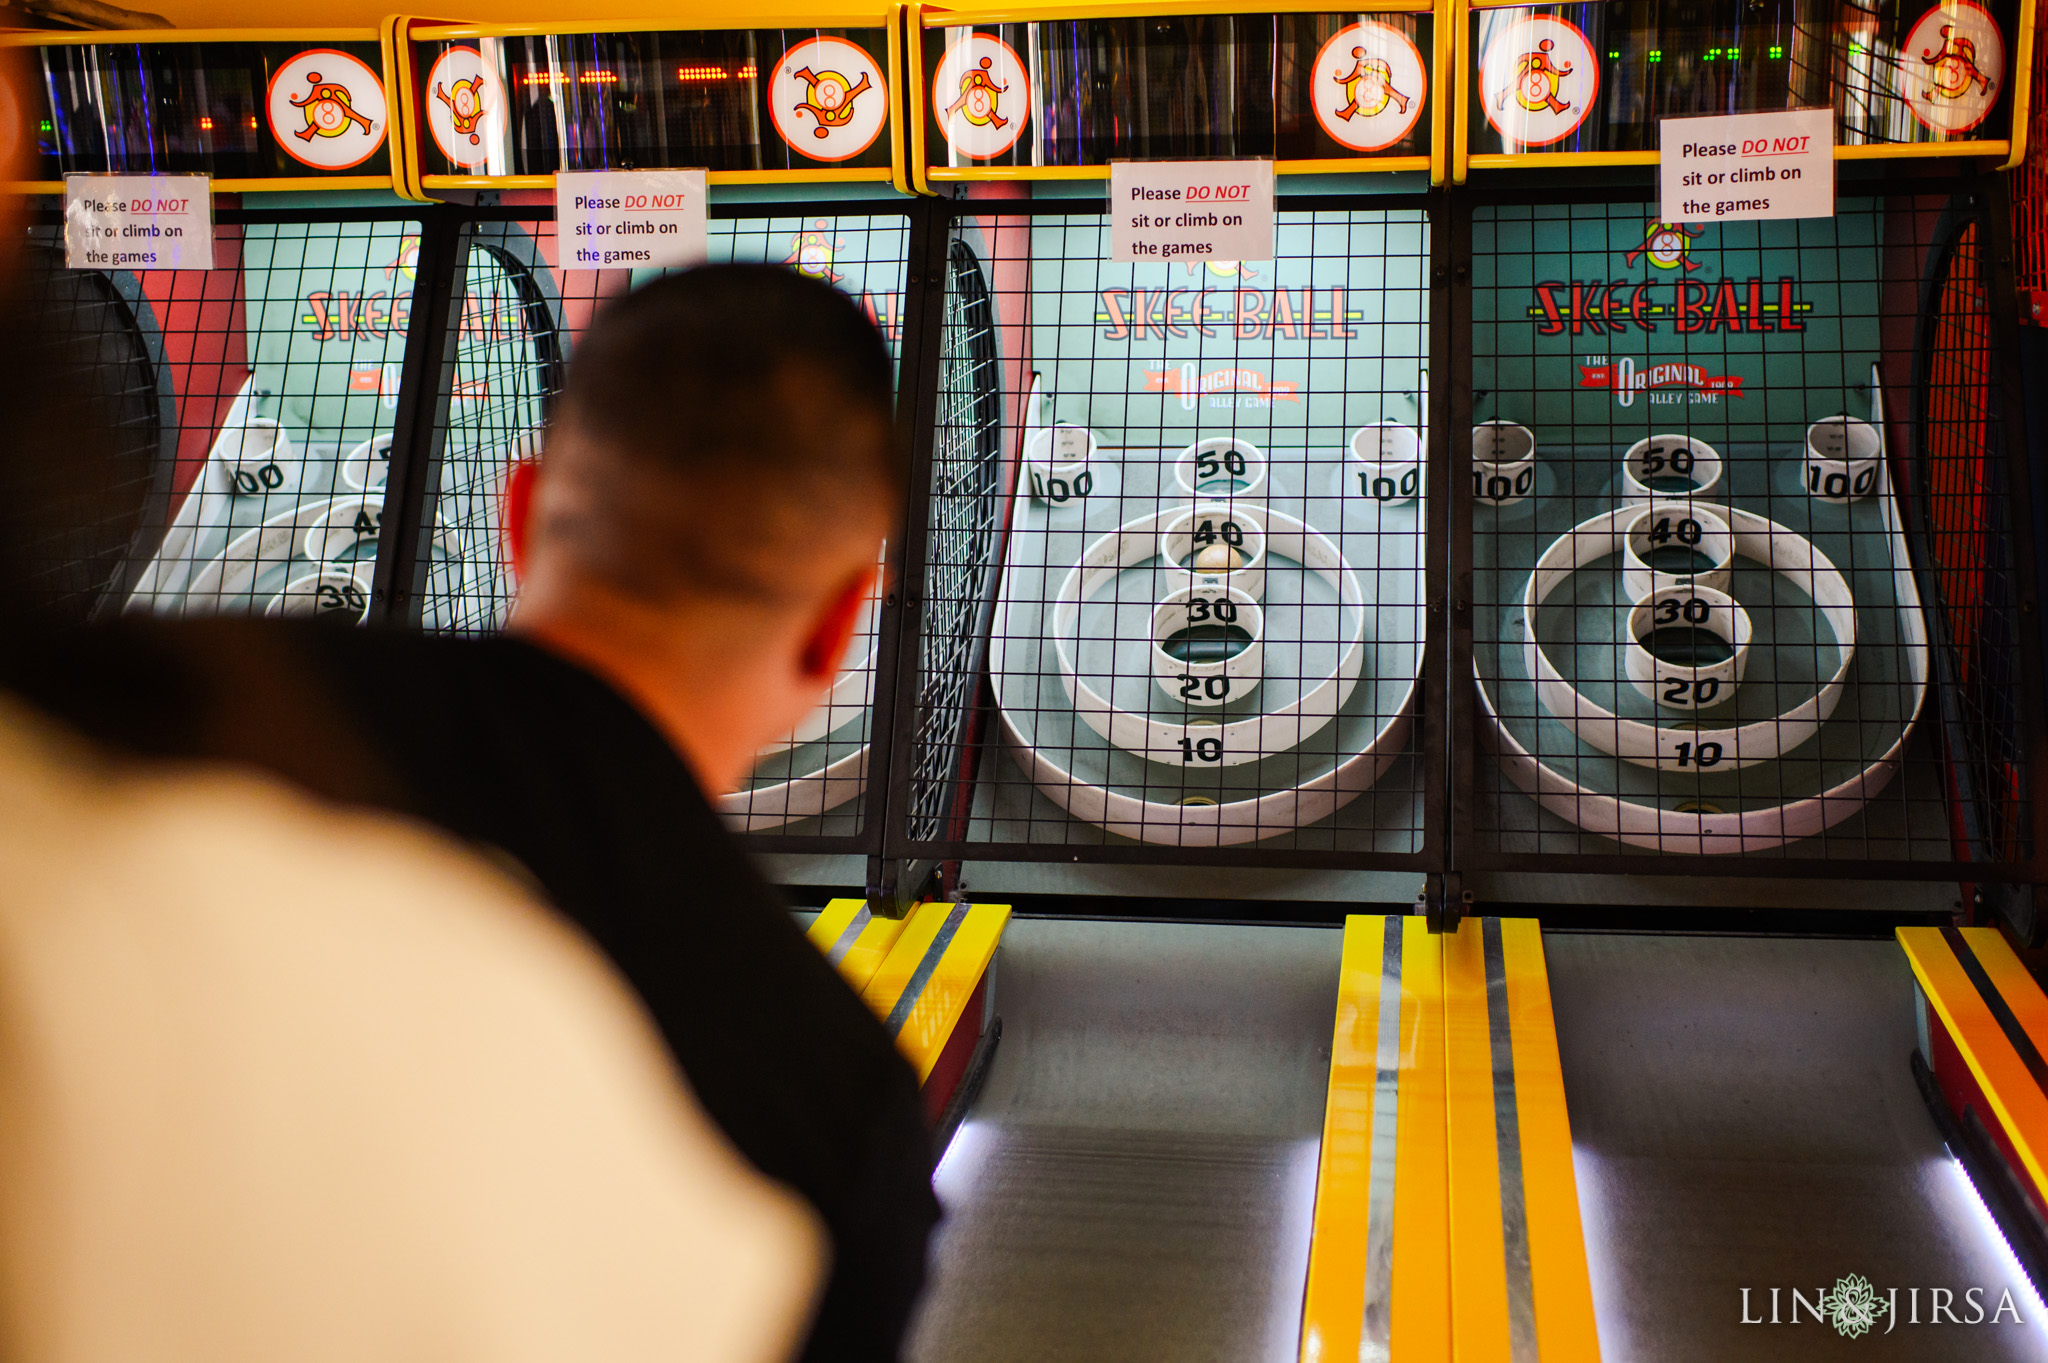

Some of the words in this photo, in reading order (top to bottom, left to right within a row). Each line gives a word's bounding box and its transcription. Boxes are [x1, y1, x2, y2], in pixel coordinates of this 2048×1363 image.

[823, 84, 836, 109] 8
[973, 88, 985, 112] 8
[321, 101, 335, 125] 8
[1682, 142, 1737, 158] Please
[1741, 139, 1768, 154] DO
[1772, 136, 1810, 152] NOT
[1682, 171, 1702, 186] sit
[1707, 173, 1726, 185] or
[1730, 166, 1776, 183] climb
[1780, 167, 1801, 180] on
[575, 196, 620, 209] Please
[624, 195, 648, 209] DO
[651, 194, 685, 208] NOT
[1131, 187, 1181, 201] Please
[1186, 186, 1210, 200] DO
[1215, 185, 1251, 199] NOT
[84, 199, 127, 212] Please
[131, 199, 153, 212] DO
[157, 199, 189, 212] NOT
[1682, 199, 1711, 215] the
[1715, 198, 1770, 216] games
[85, 225, 101, 237] sit
[104, 227, 118, 237] or
[122, 224, 160, 237] climb
[164, 227, 183, 237] on
[575, 222, 592, 235] sit
[596, 224, 612, 235] or
[615, 220, 655, 235] climb
[659, 223, 678, 234] on
[1131, 214, 1150, 228] sit
[1154, 215, 1171, 227] or
[1175, 212, 1218, 227] climb
[1222, 214, 1242, 226] on
[86, 250, 109, 263] the
[112, 252, 157, 265] games
[577, 248, 600, 261] the
[604, 249, 651, 264] games
[1132, 241, 1158, 255] the
[1162, 242, 1213, 258] games
[1150, 359, 1171, 370] THE
[1586, 355, 1608, 365] THE
[1181, 362, 1262, 411] ORIGINAL
[1619, 357, 1704, 408] ORIGINAL
[1209, 397, 1241, 408] ALLEY
[1245, 397, 1276, 408] GAME
[1688, 393, 1719, 404] GAME
[1197, 450, 1246, 478] 50
[1642, 447, 1695, 475] 50
[1034, 470, 1093, 502] 100
[1357, 468, 1418, 501] 100
[1472, 466, 1533, 501] 100
[1810, 465, 1874, 498] 100
[1194, 520, 1243, 546] 40
[1648, 518, 1702, 545] 40
[316, 585, 366, 609] 30
[1186, 597, 1237, 623] 30
[1655, 598, 1710, 624] 30
[1177, 673, 1230, 701] 20
[1663, 677, 1719, 704] 20
[1177, 737, 1223, 762] 10
[1674, 742, 1723, 767] 10
